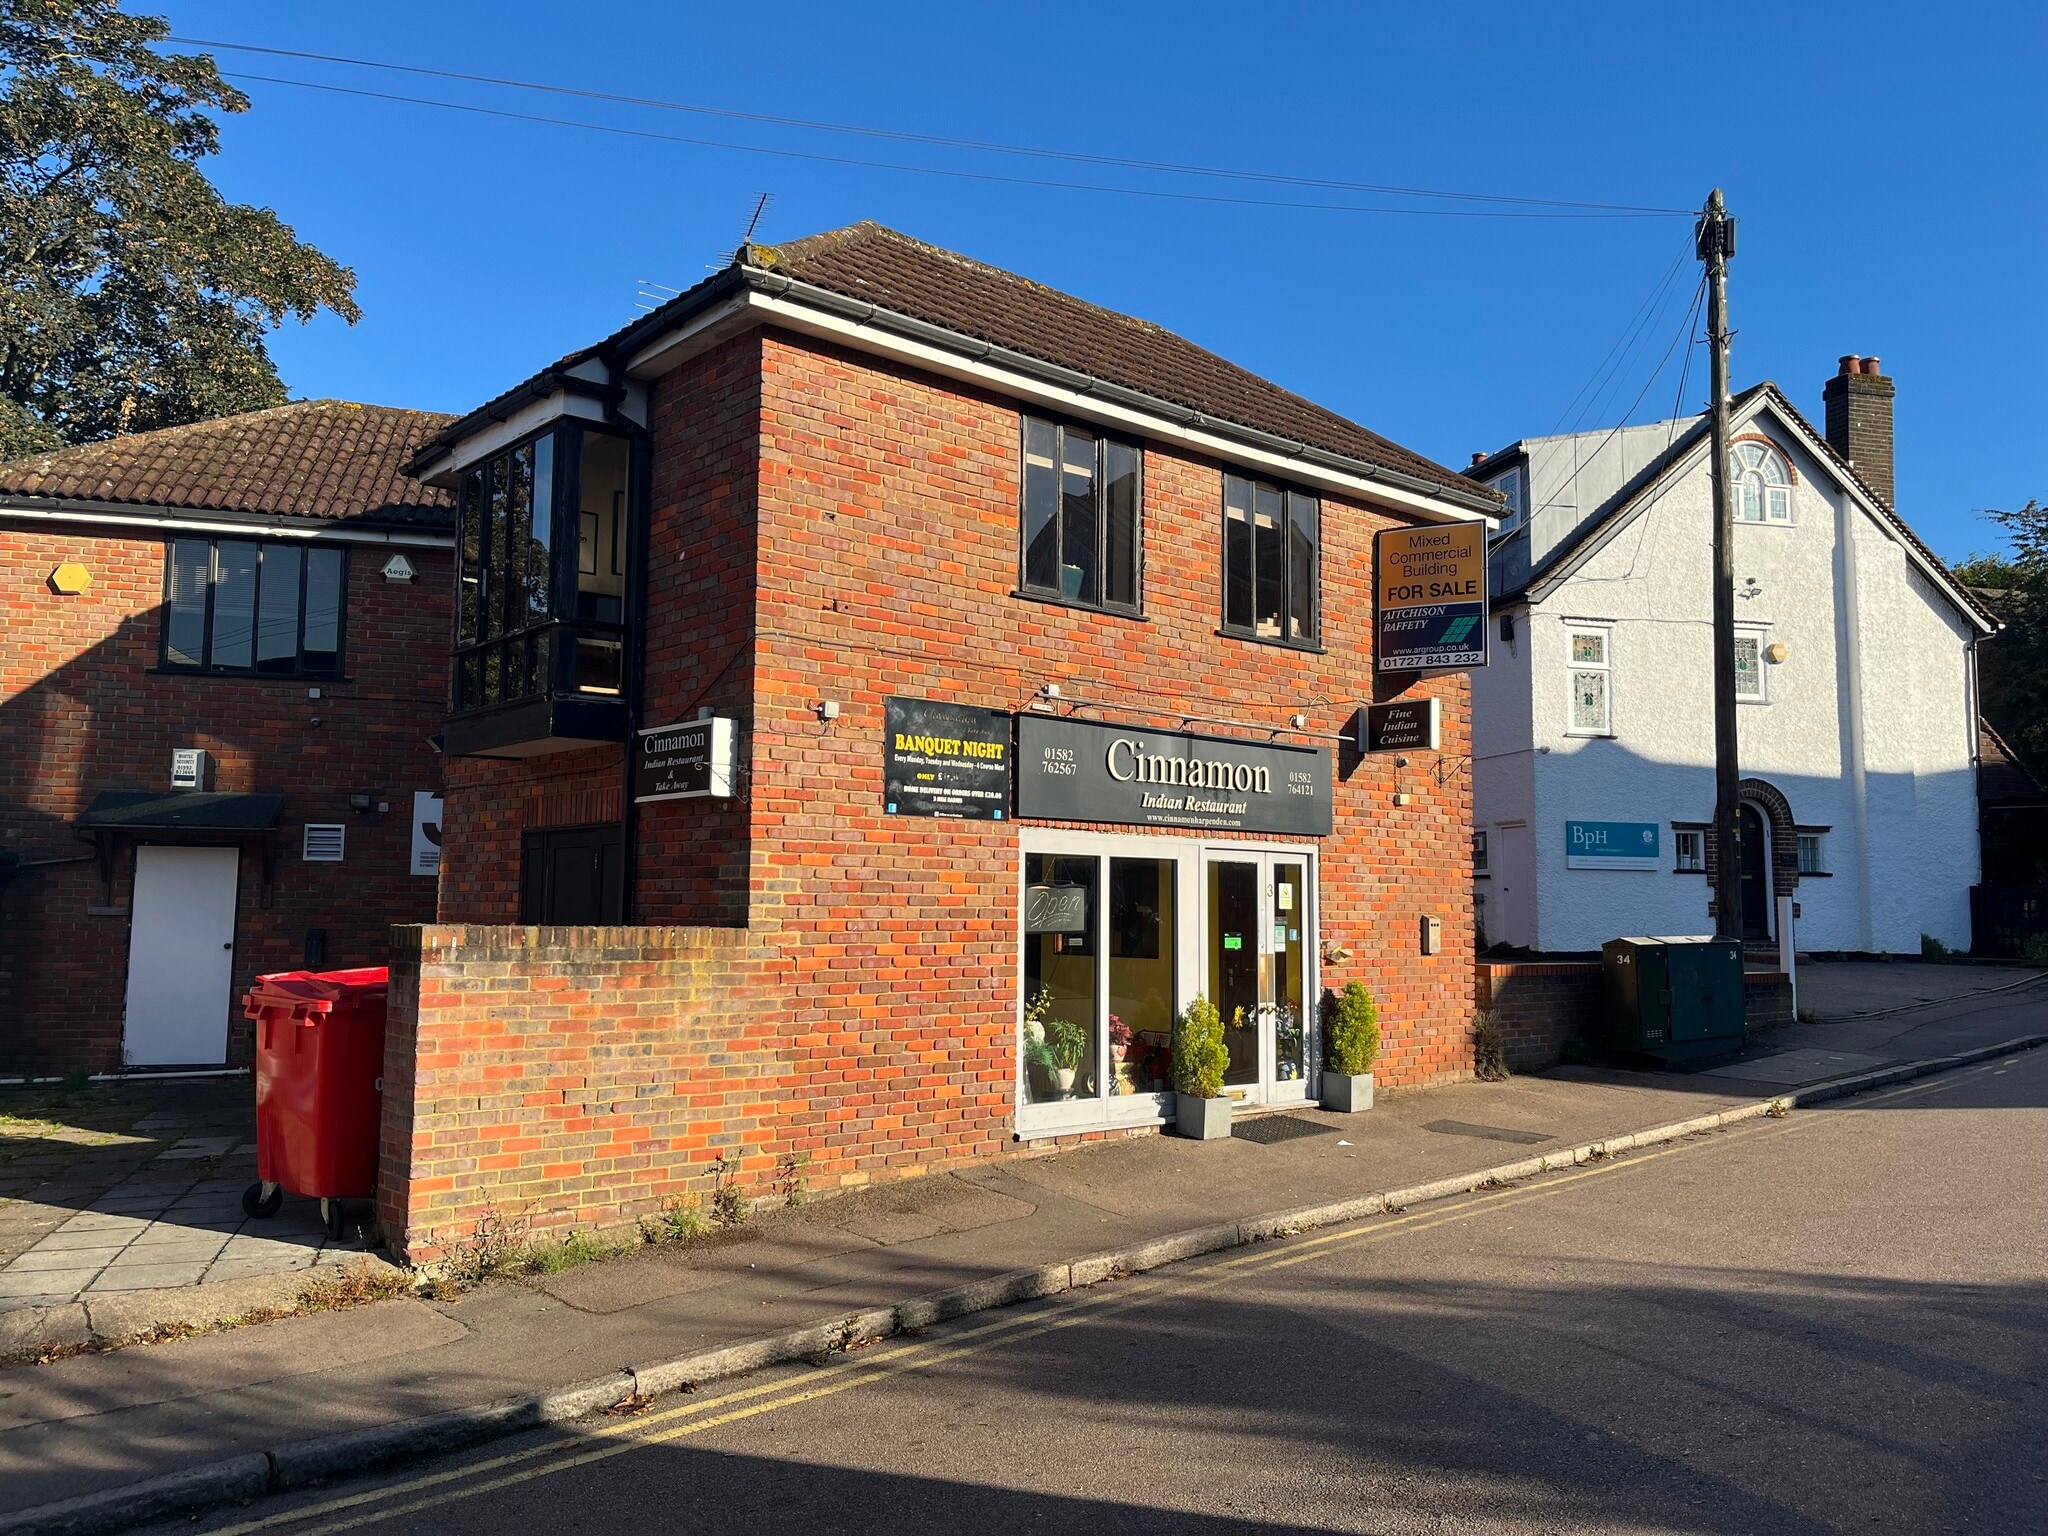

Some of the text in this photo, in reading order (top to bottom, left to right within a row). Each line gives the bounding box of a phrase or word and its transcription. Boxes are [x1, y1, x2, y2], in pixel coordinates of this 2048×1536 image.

[1409, 532, 1451, 549] Mixed
[1389, 545, 1472, 565] Commercial
[386, 568, 412, 576] Aegis
[1403, 562, 1457, 578] Building
[1388, 580, 1478, 602] FOR SALE
[1383, 606, 1447, 621] AITCHISON
[1383, 619, 1429, 633] RAFFETY
[1392, 643, 1470, 656] www.argroup.co.uk
[1383, 653, 1479, 669] 01727 843 232
[1388, 709, 1413, 720] Fine
[1382, 720, 1418, 732] Indian
[644, 732, 705, 754] Cinnamon
[1380, 733, 1420, 745] Cuisine
[895, 733, 1004, 760] BANQUET NIGHT
[1044, 747, 1074, 761] 01582
[644, 754, 704, 770] Indian Restaurant
[894, 754, 907, 764] Every
[925, 756, 942, 767] Tuesday
[942, 759, 951, 767] and
[980, 762, 994, 771] Course
[994, 763, 1005, 772] Meal
[1041, 761, 1077, 776] 762567
[1106, 738, 1272, 795] Cinnamon
[667, 770, 674, 780] &
[916, 772, 935, 780] ONLY
[1289, 771, 1312, 784] 01582
[655, 781, 689, 792] Take Away
[903, 785, 919, 794] HOME
[919, 786, 943, 795] DELIVERY
[943, 788, 952, 796] ON
[952, 788, 971, 798] ORDERS
[971, 790, 984, 798] OVER
[1287, 783, 1314, 796] 764121
[947, 796, 963, 804] RADIUS
[1141, 792, 1248, 815] Indian Restaurant
[1146, 813, 1242, 827] www.cinnamonharpenden.com
[1572, 825, 1608, 850] BpH
[1267, 884, 1274, 898] 3
[1028, 891, 1081, 928] Open
[1616, 954, 1630, 965] 34
[1729, 950, 1737, 960] 34
